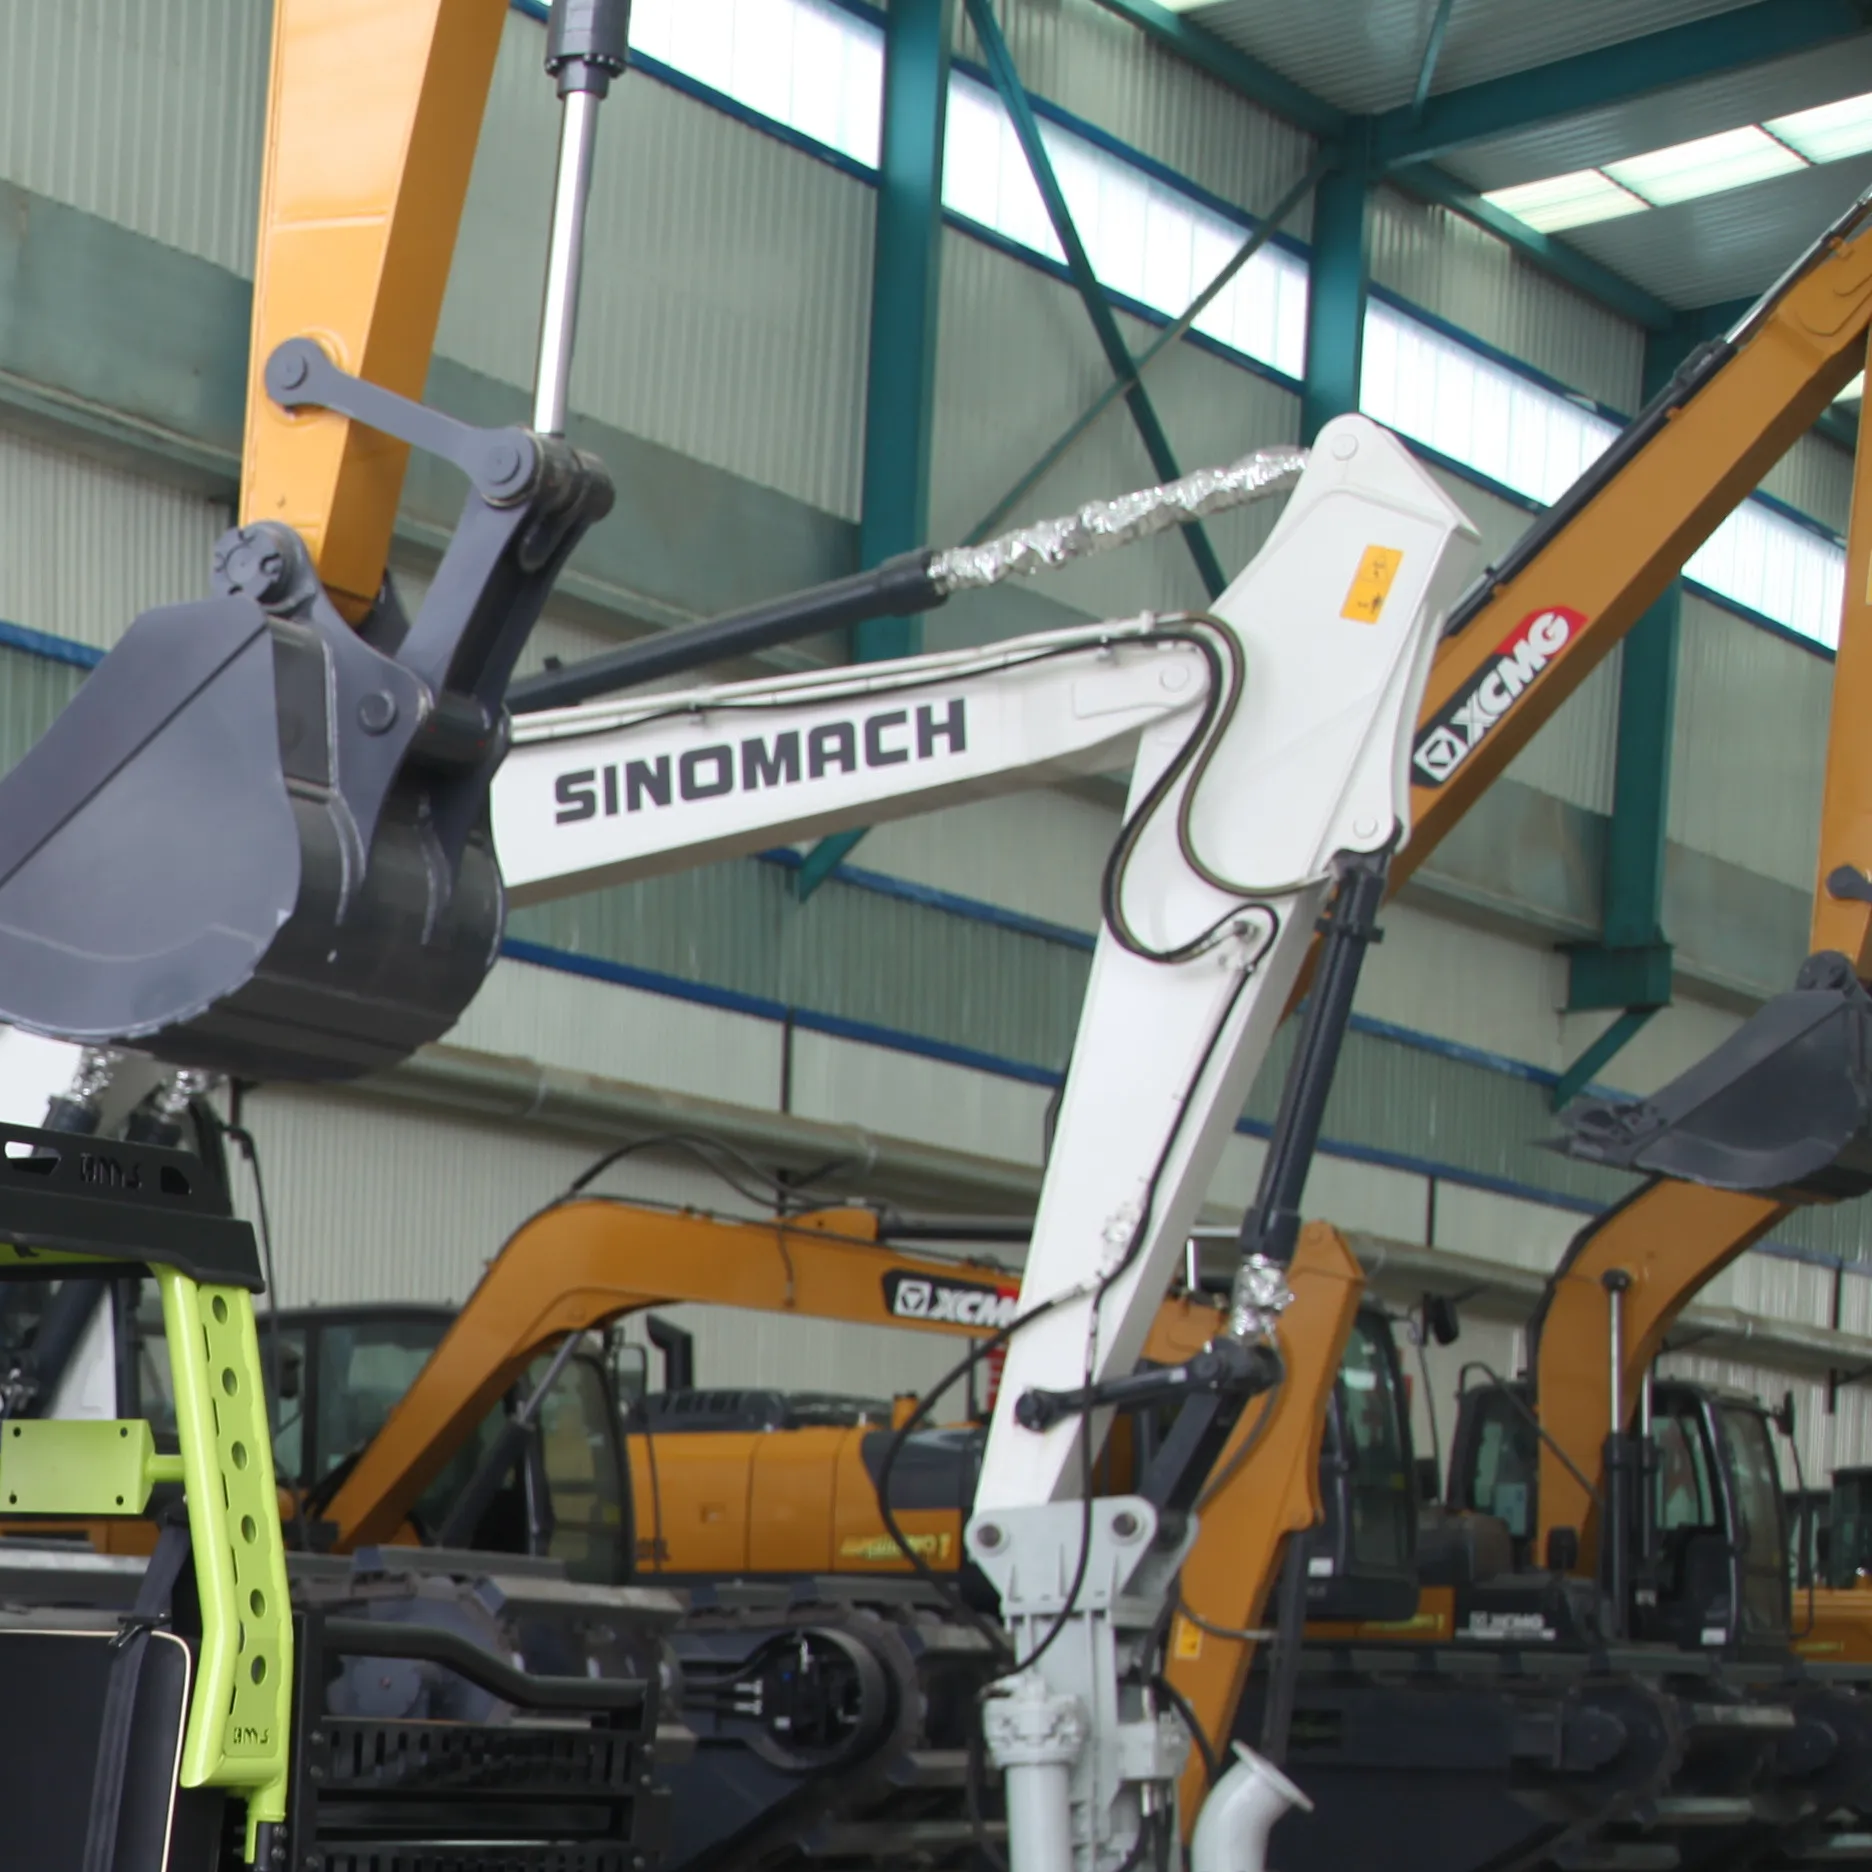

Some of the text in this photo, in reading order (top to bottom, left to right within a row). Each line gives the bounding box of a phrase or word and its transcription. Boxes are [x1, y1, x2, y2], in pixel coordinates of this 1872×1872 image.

[1450, 612, 1569, 747] XCMG
[555, 698, 966, 825] SINOMACH
[929, 1286, 1019, 1328] XCM
